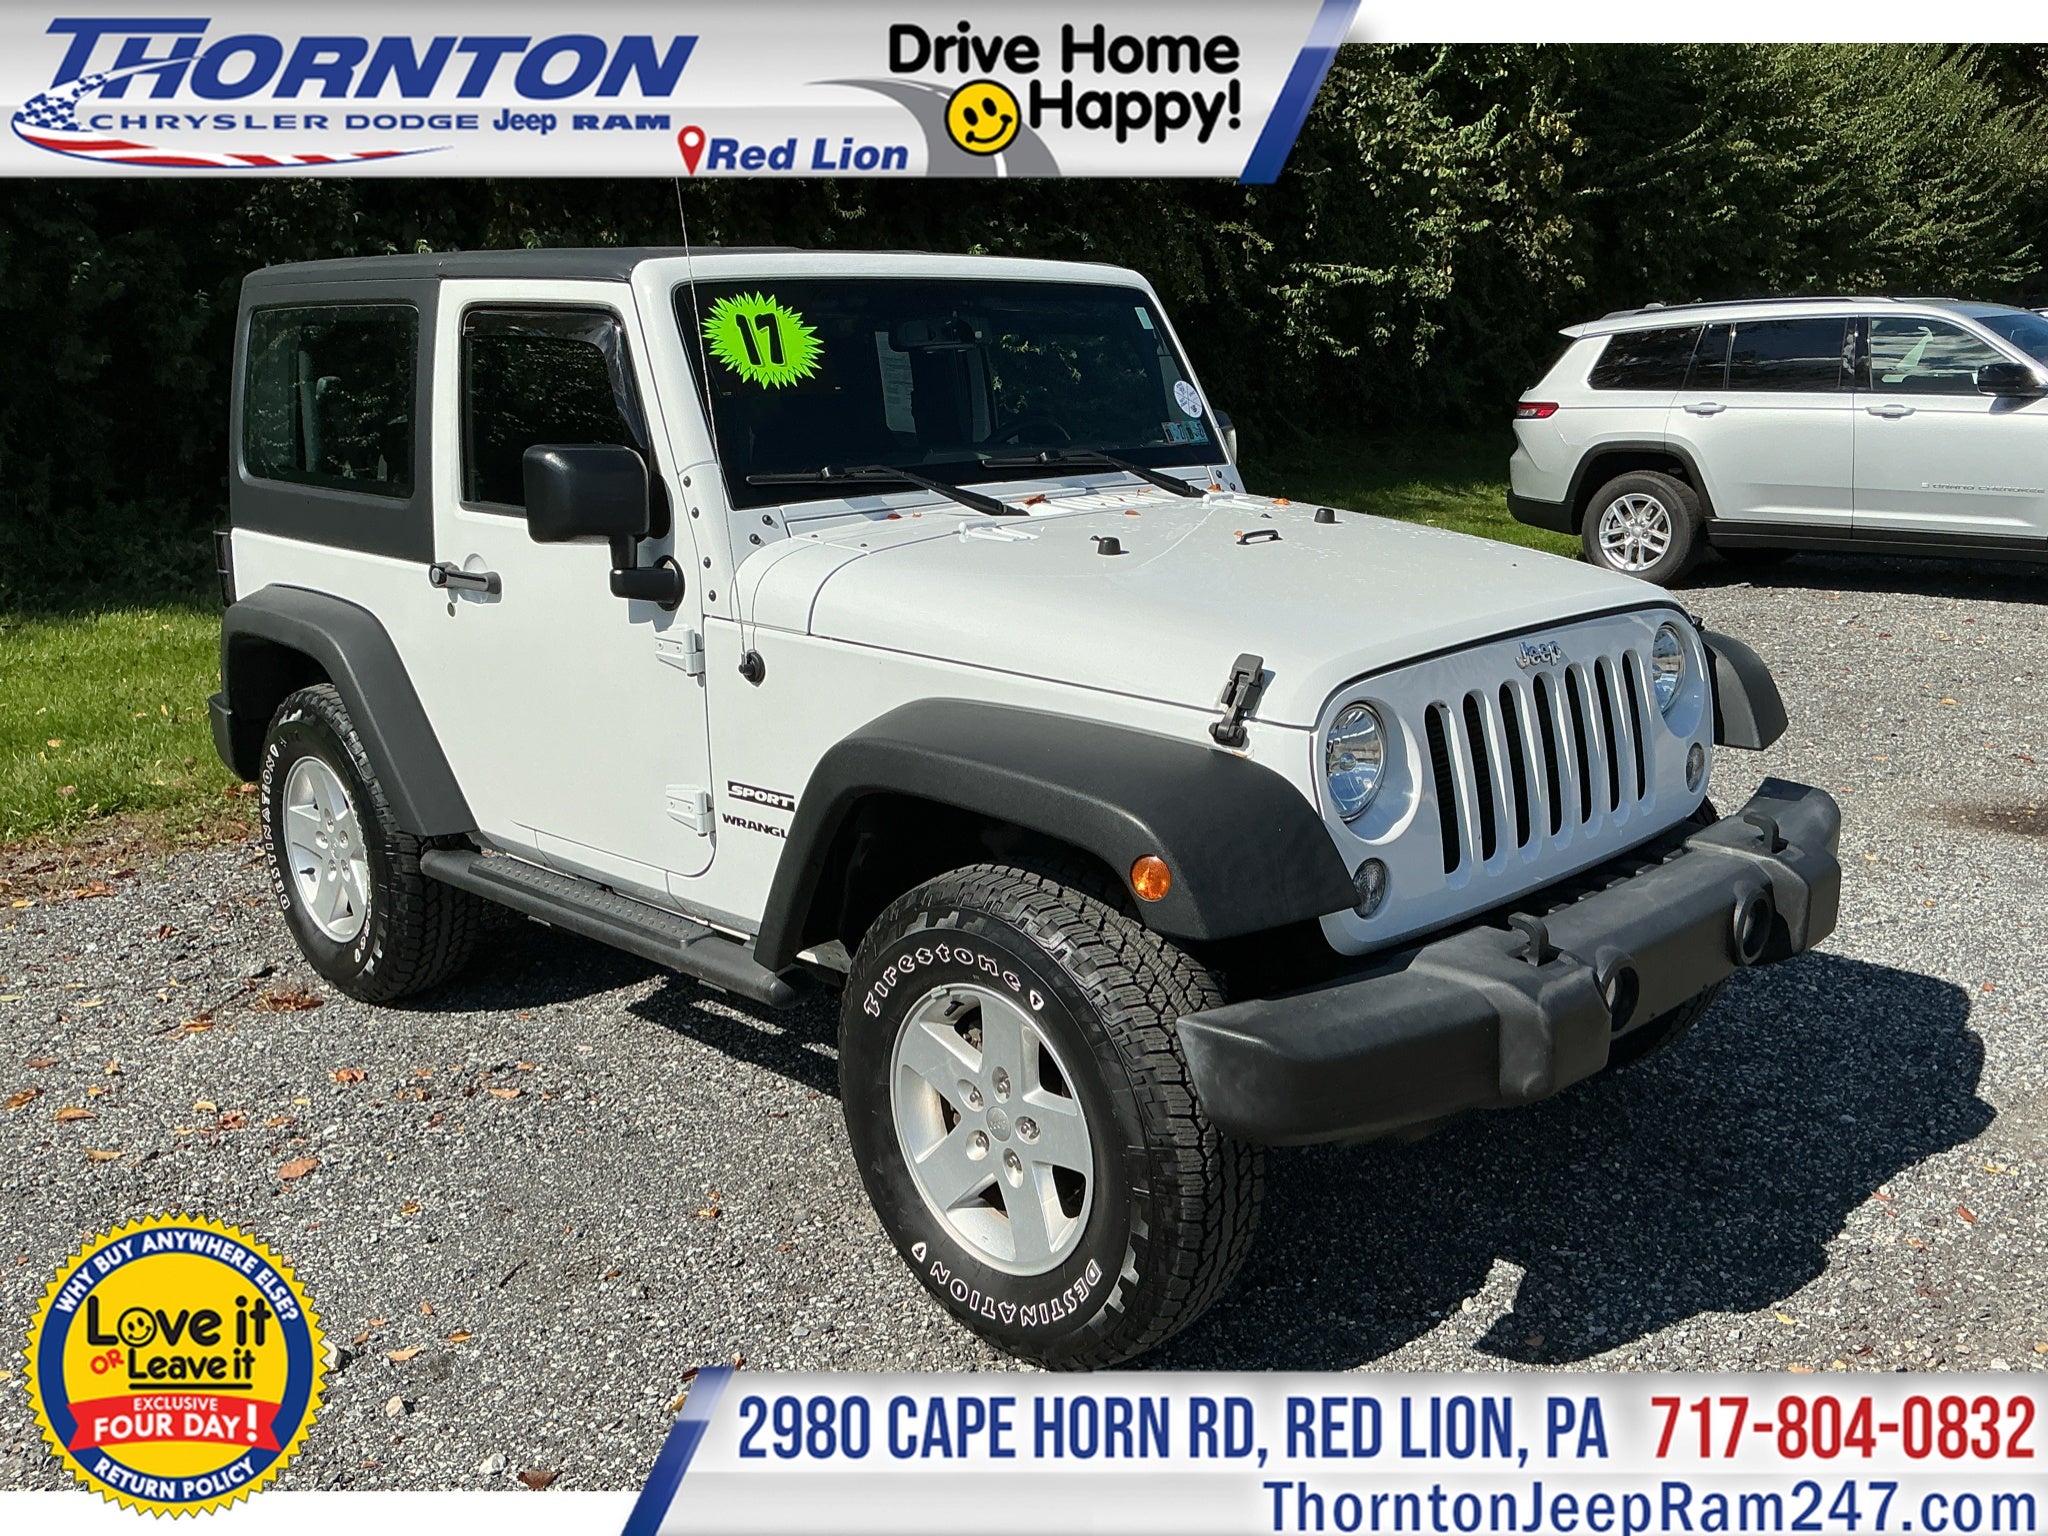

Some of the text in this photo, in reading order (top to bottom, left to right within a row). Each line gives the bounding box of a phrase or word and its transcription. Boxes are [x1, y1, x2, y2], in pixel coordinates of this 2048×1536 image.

[736, 312, 786, 367] 17
[1515, 640, 1562, 669] Jeep
[731, 785, 795, 808] SPORT
[262, 754, 291, 909] DESTINATION
[864, 943, 1021, 1017] Firestone
[930, 1258, 1103, 1327] DESTINATION
